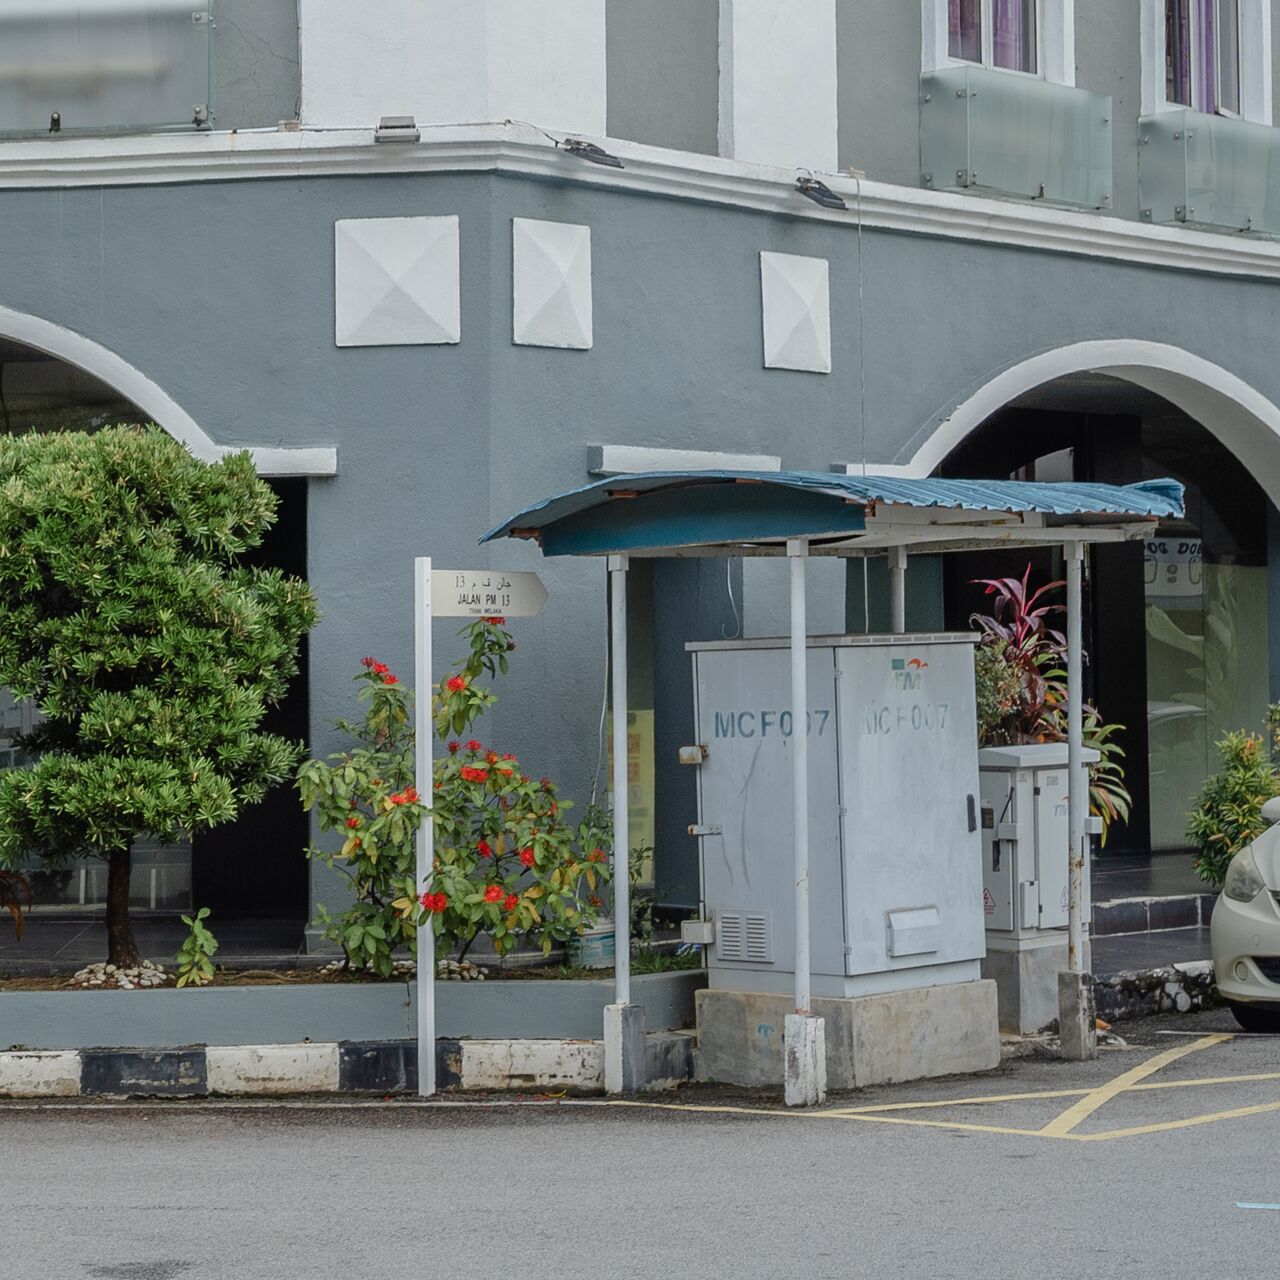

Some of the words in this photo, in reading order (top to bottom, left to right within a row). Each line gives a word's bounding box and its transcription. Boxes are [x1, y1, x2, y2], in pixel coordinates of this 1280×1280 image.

[455, 575, 465, 588] 13
[458, 594, 481, 605] JALAN
[485, 594, 497, 605] PM
[502, 594, 510, 606] 13
